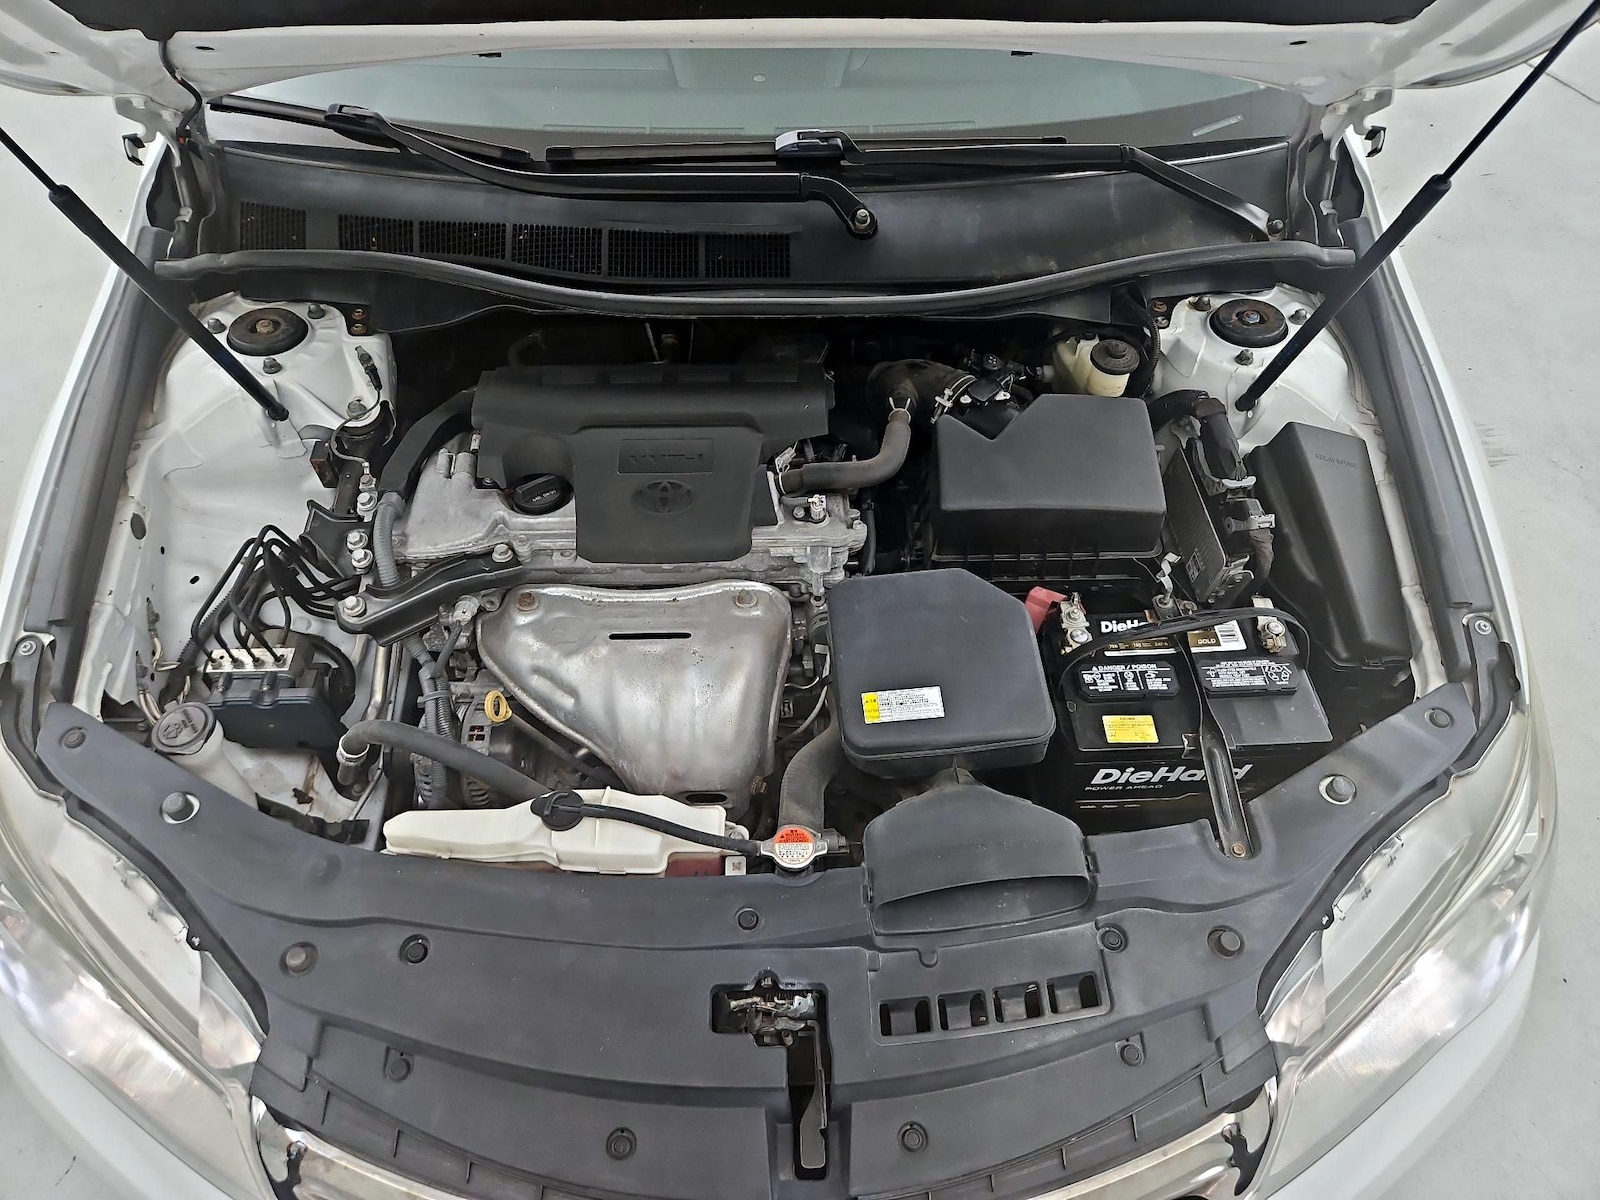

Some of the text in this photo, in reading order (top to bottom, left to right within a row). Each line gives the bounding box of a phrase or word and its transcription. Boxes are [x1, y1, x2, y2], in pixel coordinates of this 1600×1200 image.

[1090, 764, 1254, 785] DieHad
[1084, 784, 1164, 793] POWER AHEAD
